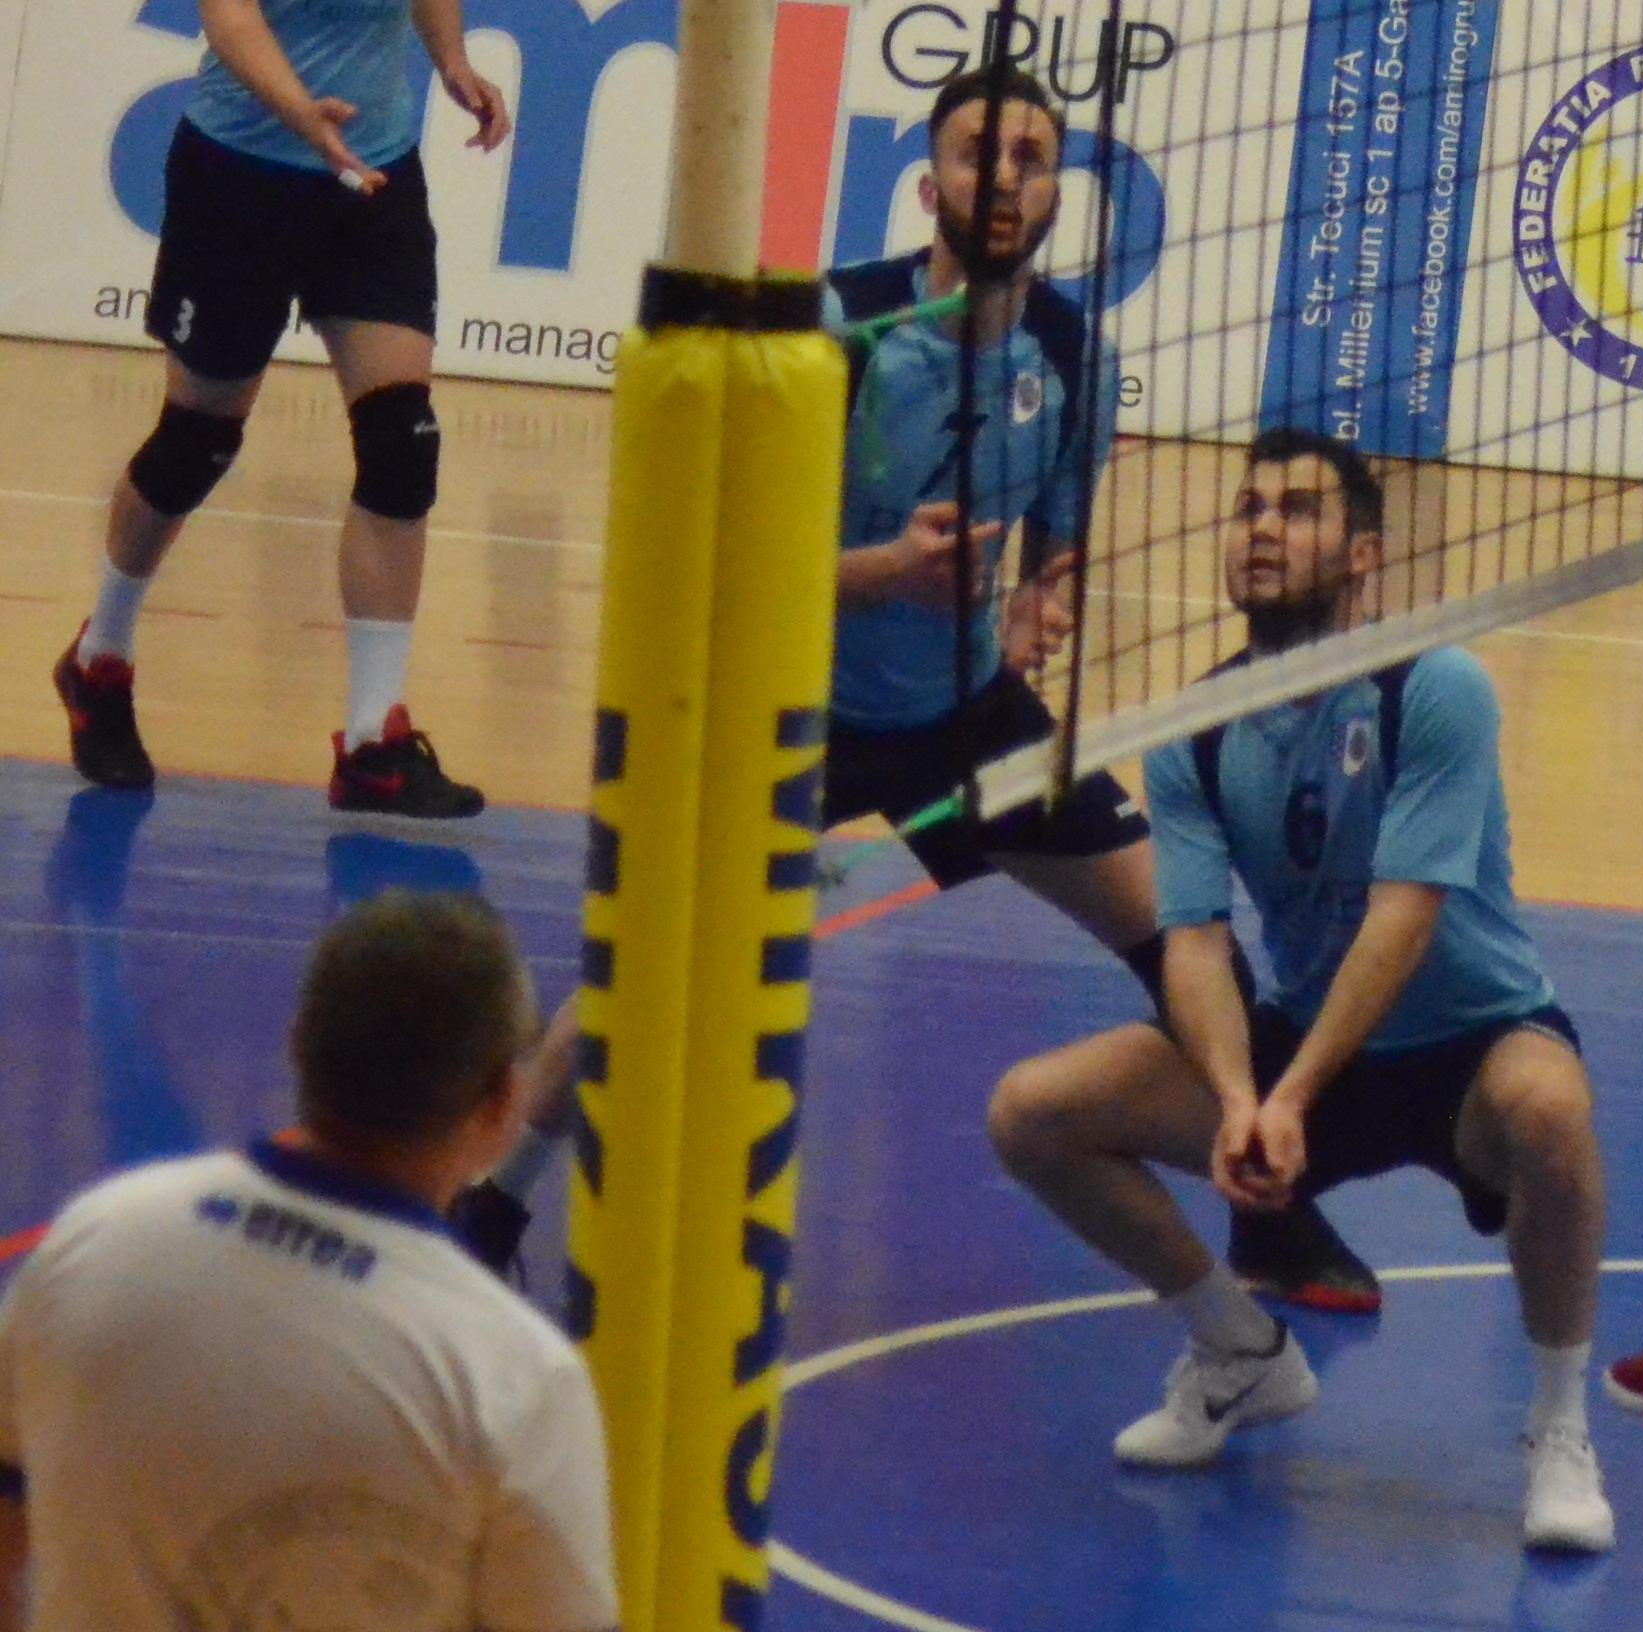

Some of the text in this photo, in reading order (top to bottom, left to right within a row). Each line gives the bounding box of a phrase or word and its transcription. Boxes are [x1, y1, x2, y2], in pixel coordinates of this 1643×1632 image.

[881, 3, 1176, 106] GRUP
[1375, 90, 1407, 133] ap
[1300, 48, 1364, 326] Str. Tecuci 157A
[1363, 174, 1390, 213] sc
